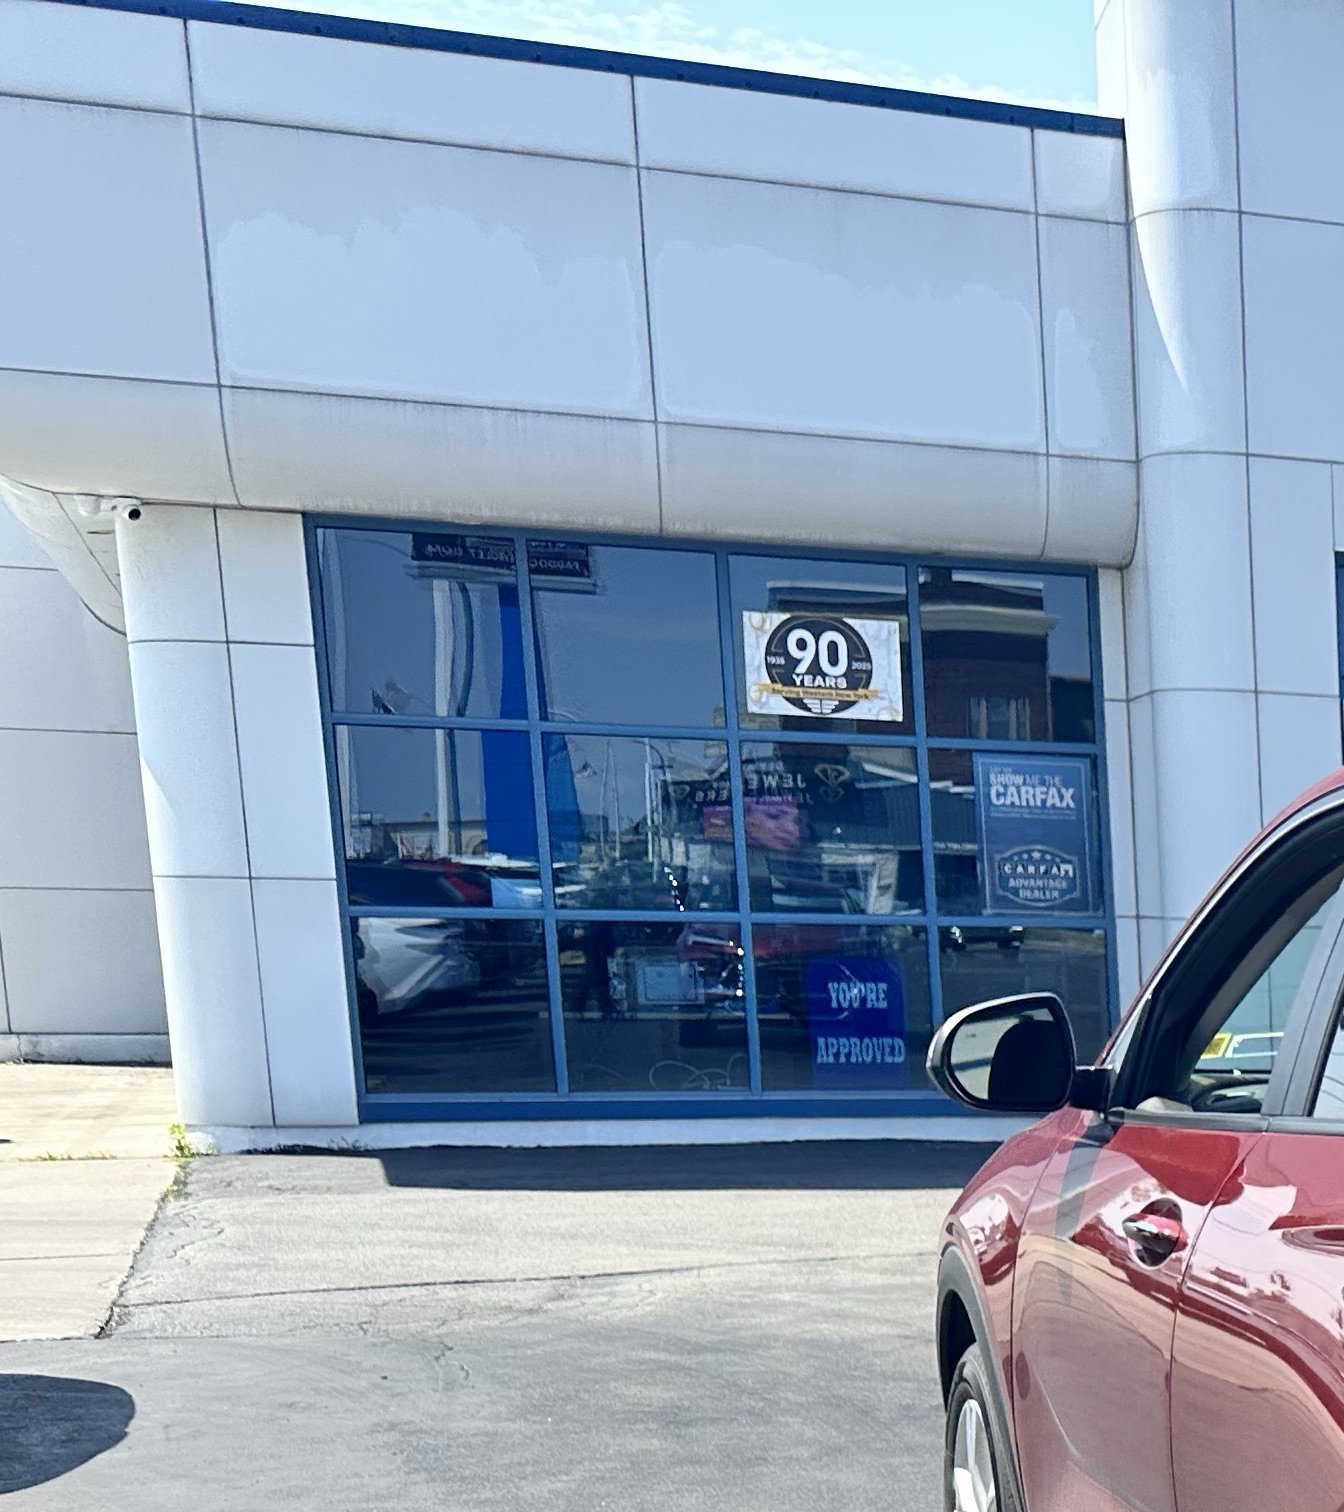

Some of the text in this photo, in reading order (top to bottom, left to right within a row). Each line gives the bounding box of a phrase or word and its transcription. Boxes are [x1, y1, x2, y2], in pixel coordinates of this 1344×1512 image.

[787, 628, 849, 677] 90
[791, 673, 848, 689] YEARS
[989, 772, 1024, 786] SHOW
[989, 784, 1076, 809] CARFAX
[1008, 877, 1068, 890] ADVANTAGE
[1018, 889, 1060, 900] DEALER
[827, 981, 889, 1009] YOU'RE
[816, 1037, 906, 1064] APPROVED
